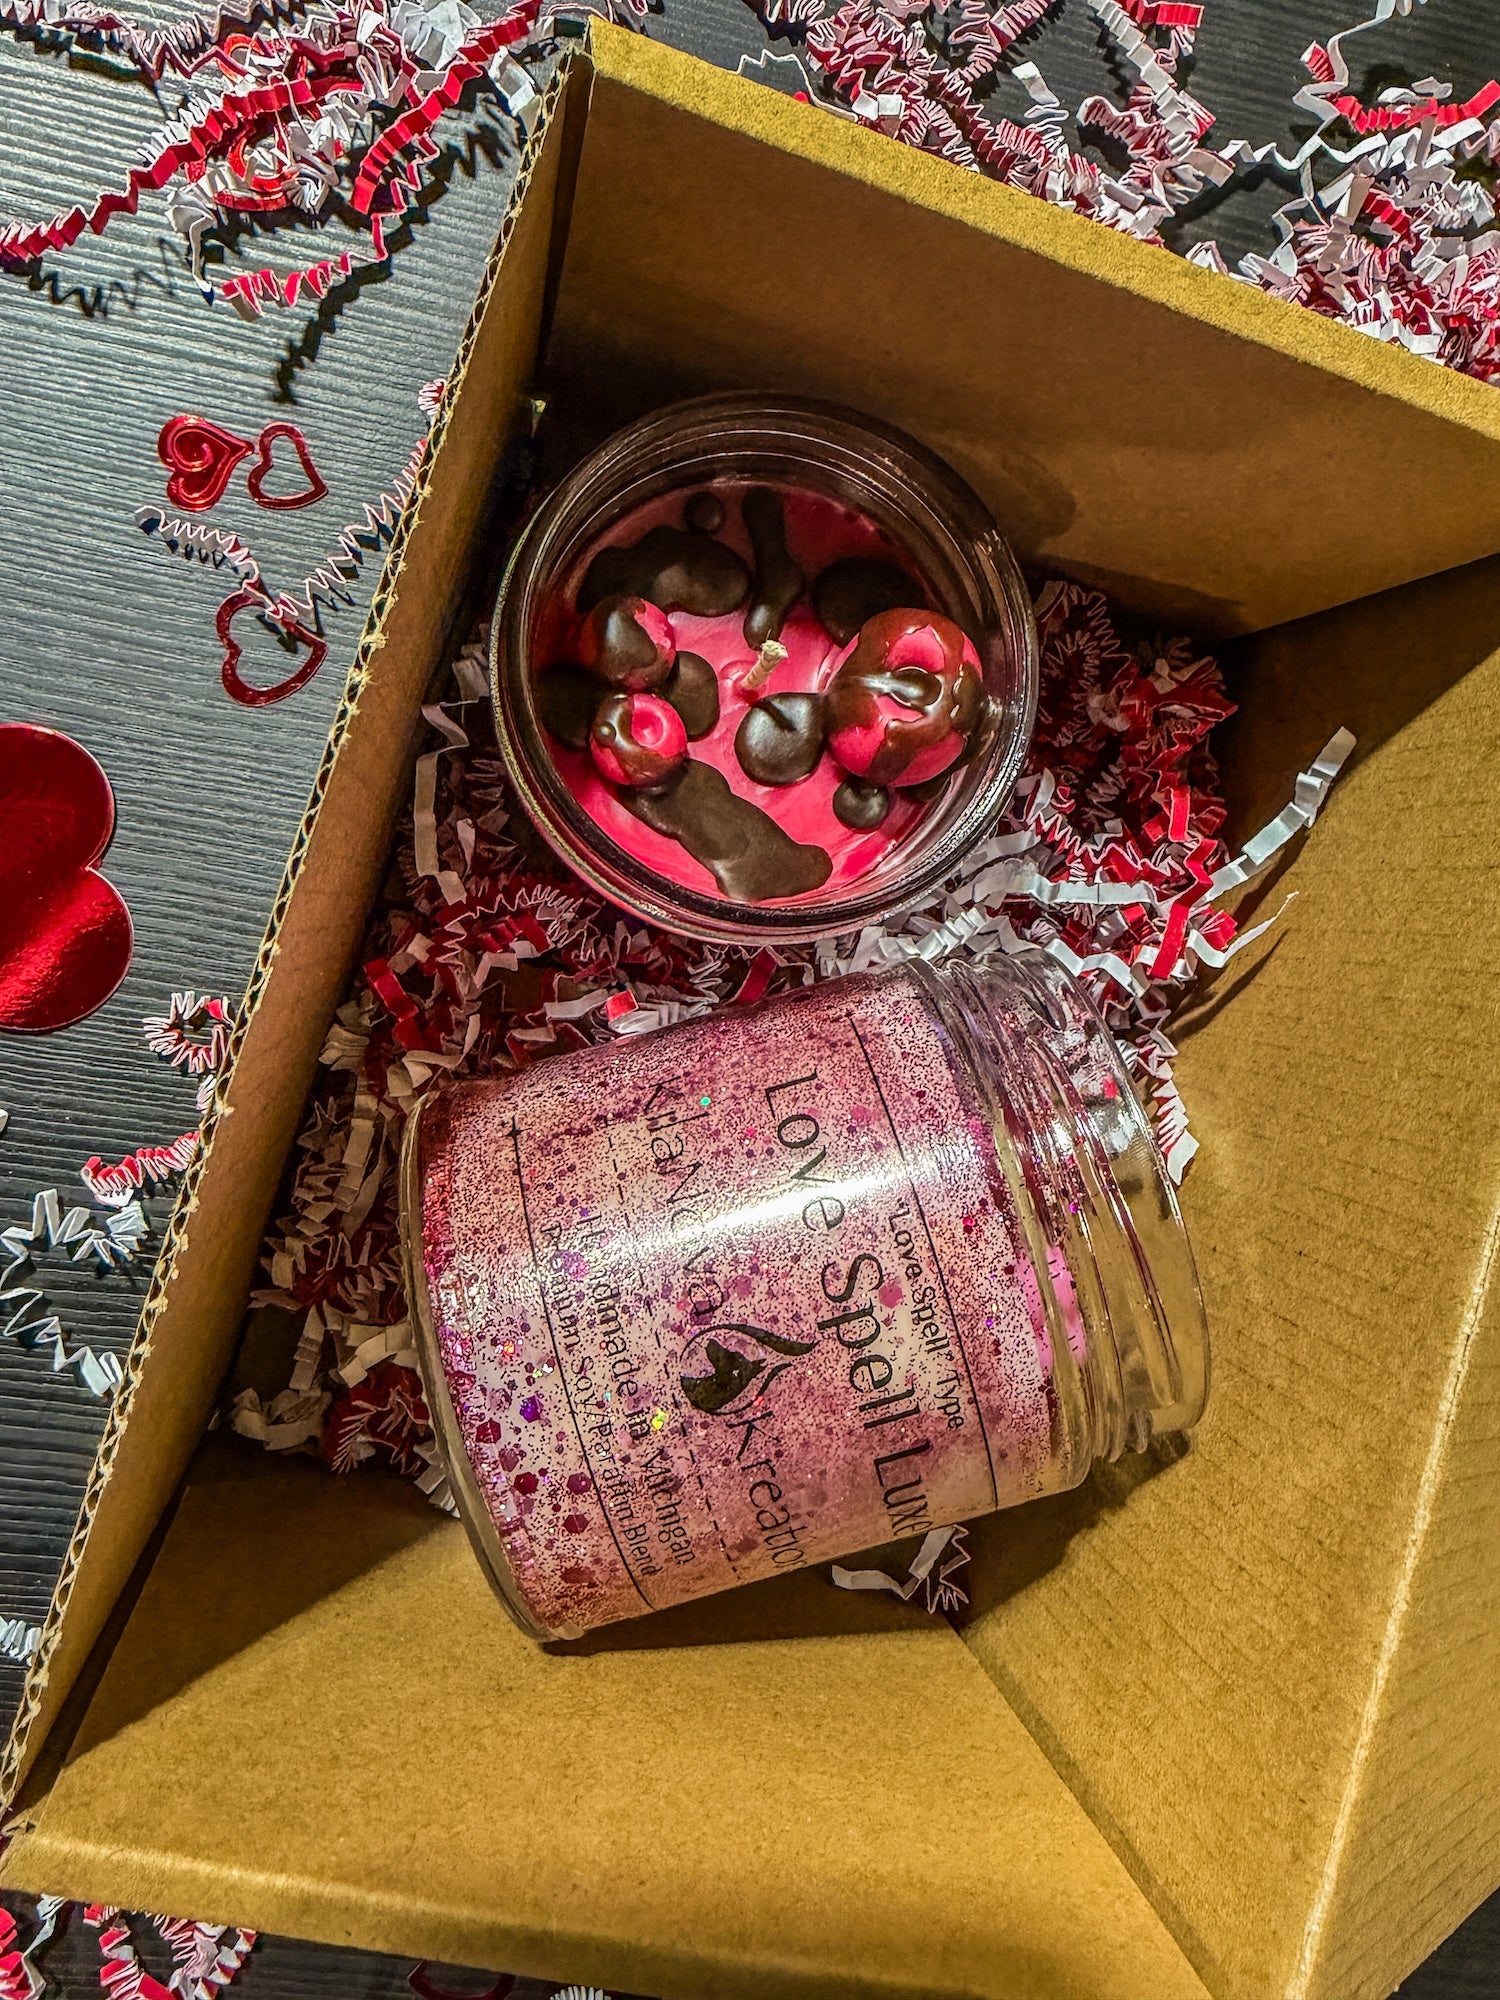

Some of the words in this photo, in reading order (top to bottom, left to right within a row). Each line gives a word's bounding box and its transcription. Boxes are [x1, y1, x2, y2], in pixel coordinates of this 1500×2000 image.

[577, 1212, 641, 1397] Hndmade
[623, 1407, 652, 1441] in
[639, 1450, 697, 1565] Michigan
[764, 1068, 846, 1232] Love
[816, 1253, 921, 1430] Spell
[872, 1438, 932, 1537] Luxe
[932, 1369, 963, 1431] Type
[621, 1525, 662, 1577] Blend
